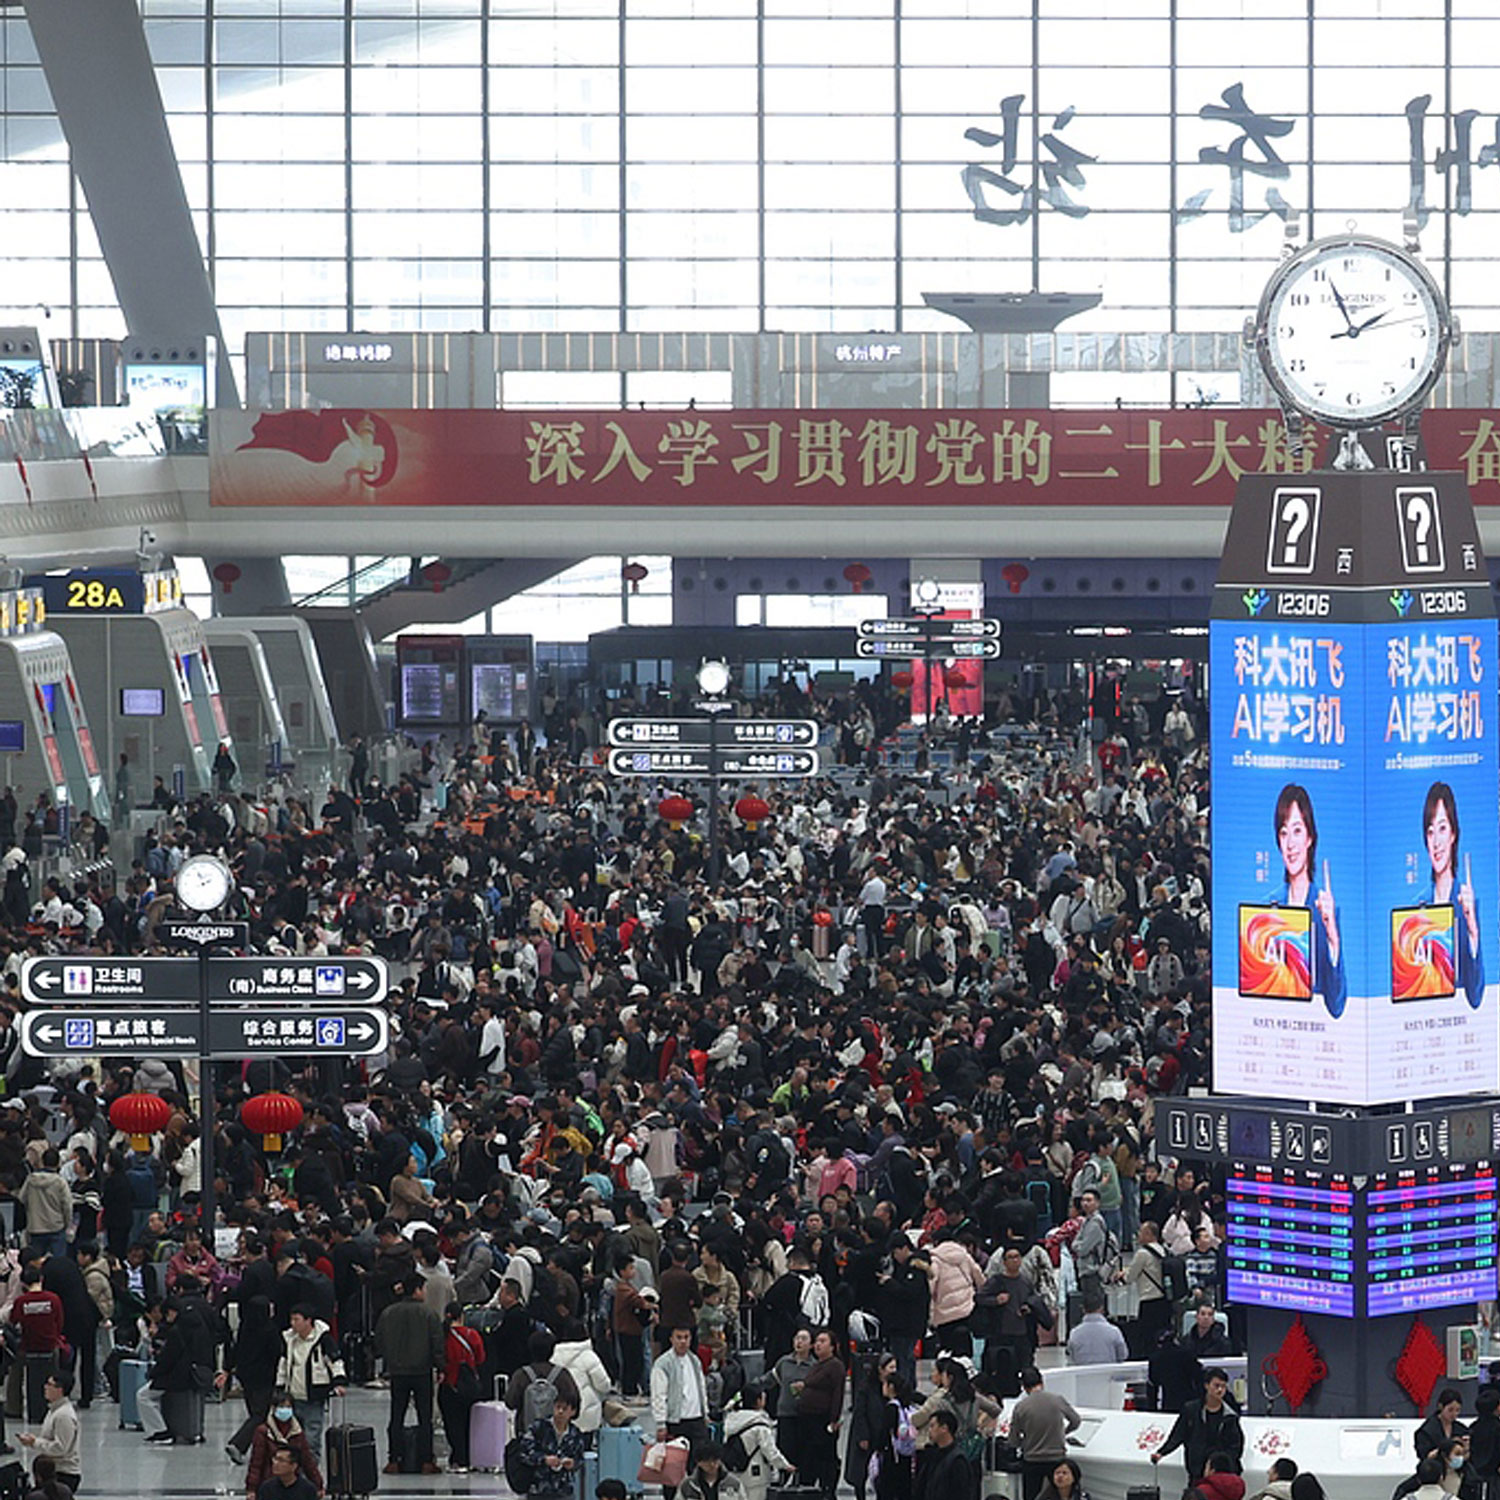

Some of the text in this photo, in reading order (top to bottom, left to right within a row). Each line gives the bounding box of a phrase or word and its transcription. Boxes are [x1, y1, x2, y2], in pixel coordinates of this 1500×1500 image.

[1320, 293, 1387, 303] LOGINES
[525, 419, 1329, 487] 深入学习贯彻党的二十大精
[68, 580, 124, 607] 28A
[1277, 593, 1330, 616] 12306
[1420, 590, 1466, 614] 12306
[1234, 634, 1345, 689] 科大讯飞
[1387, 634, 1484, 688] 科大讯飞
[1231, 691, 1345, 745] AI学习机
[1384, 689, 1484, 744] AI学习机
[171, 926, 235, 938] LONGINES
[95, 967, 143, 984] 卫生间
[243, 1019, 313, 1036] 综合服务
